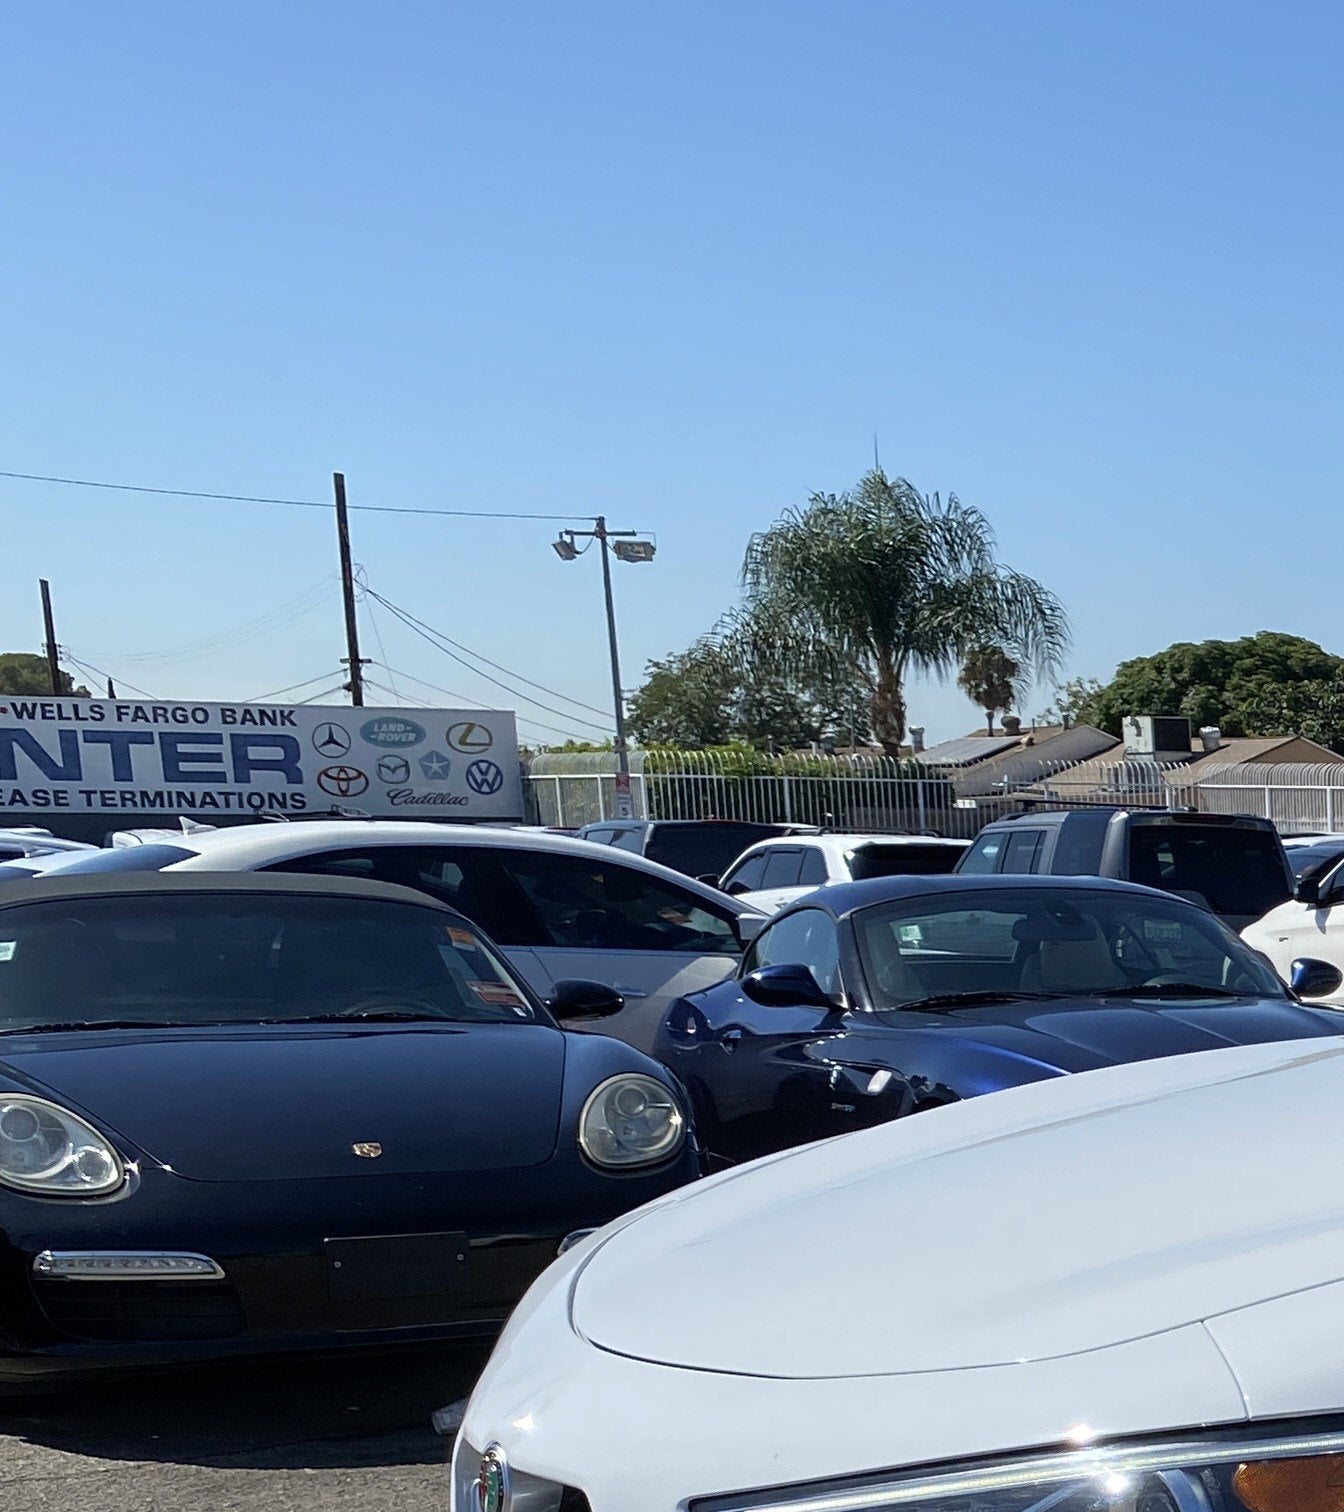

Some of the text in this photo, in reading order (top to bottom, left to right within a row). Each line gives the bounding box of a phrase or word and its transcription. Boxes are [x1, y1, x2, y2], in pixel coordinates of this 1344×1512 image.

[10, 702, 298, 727] WELLS FARGO BANK
[374, 723, 405, 732] LAND
[377, 732, 416, 742] ROVER
[0, 728, 304, 784] NTER
[79, 789, 307, 810] TERMINATIONS
[387, 788, 469, 807] Cadillac
